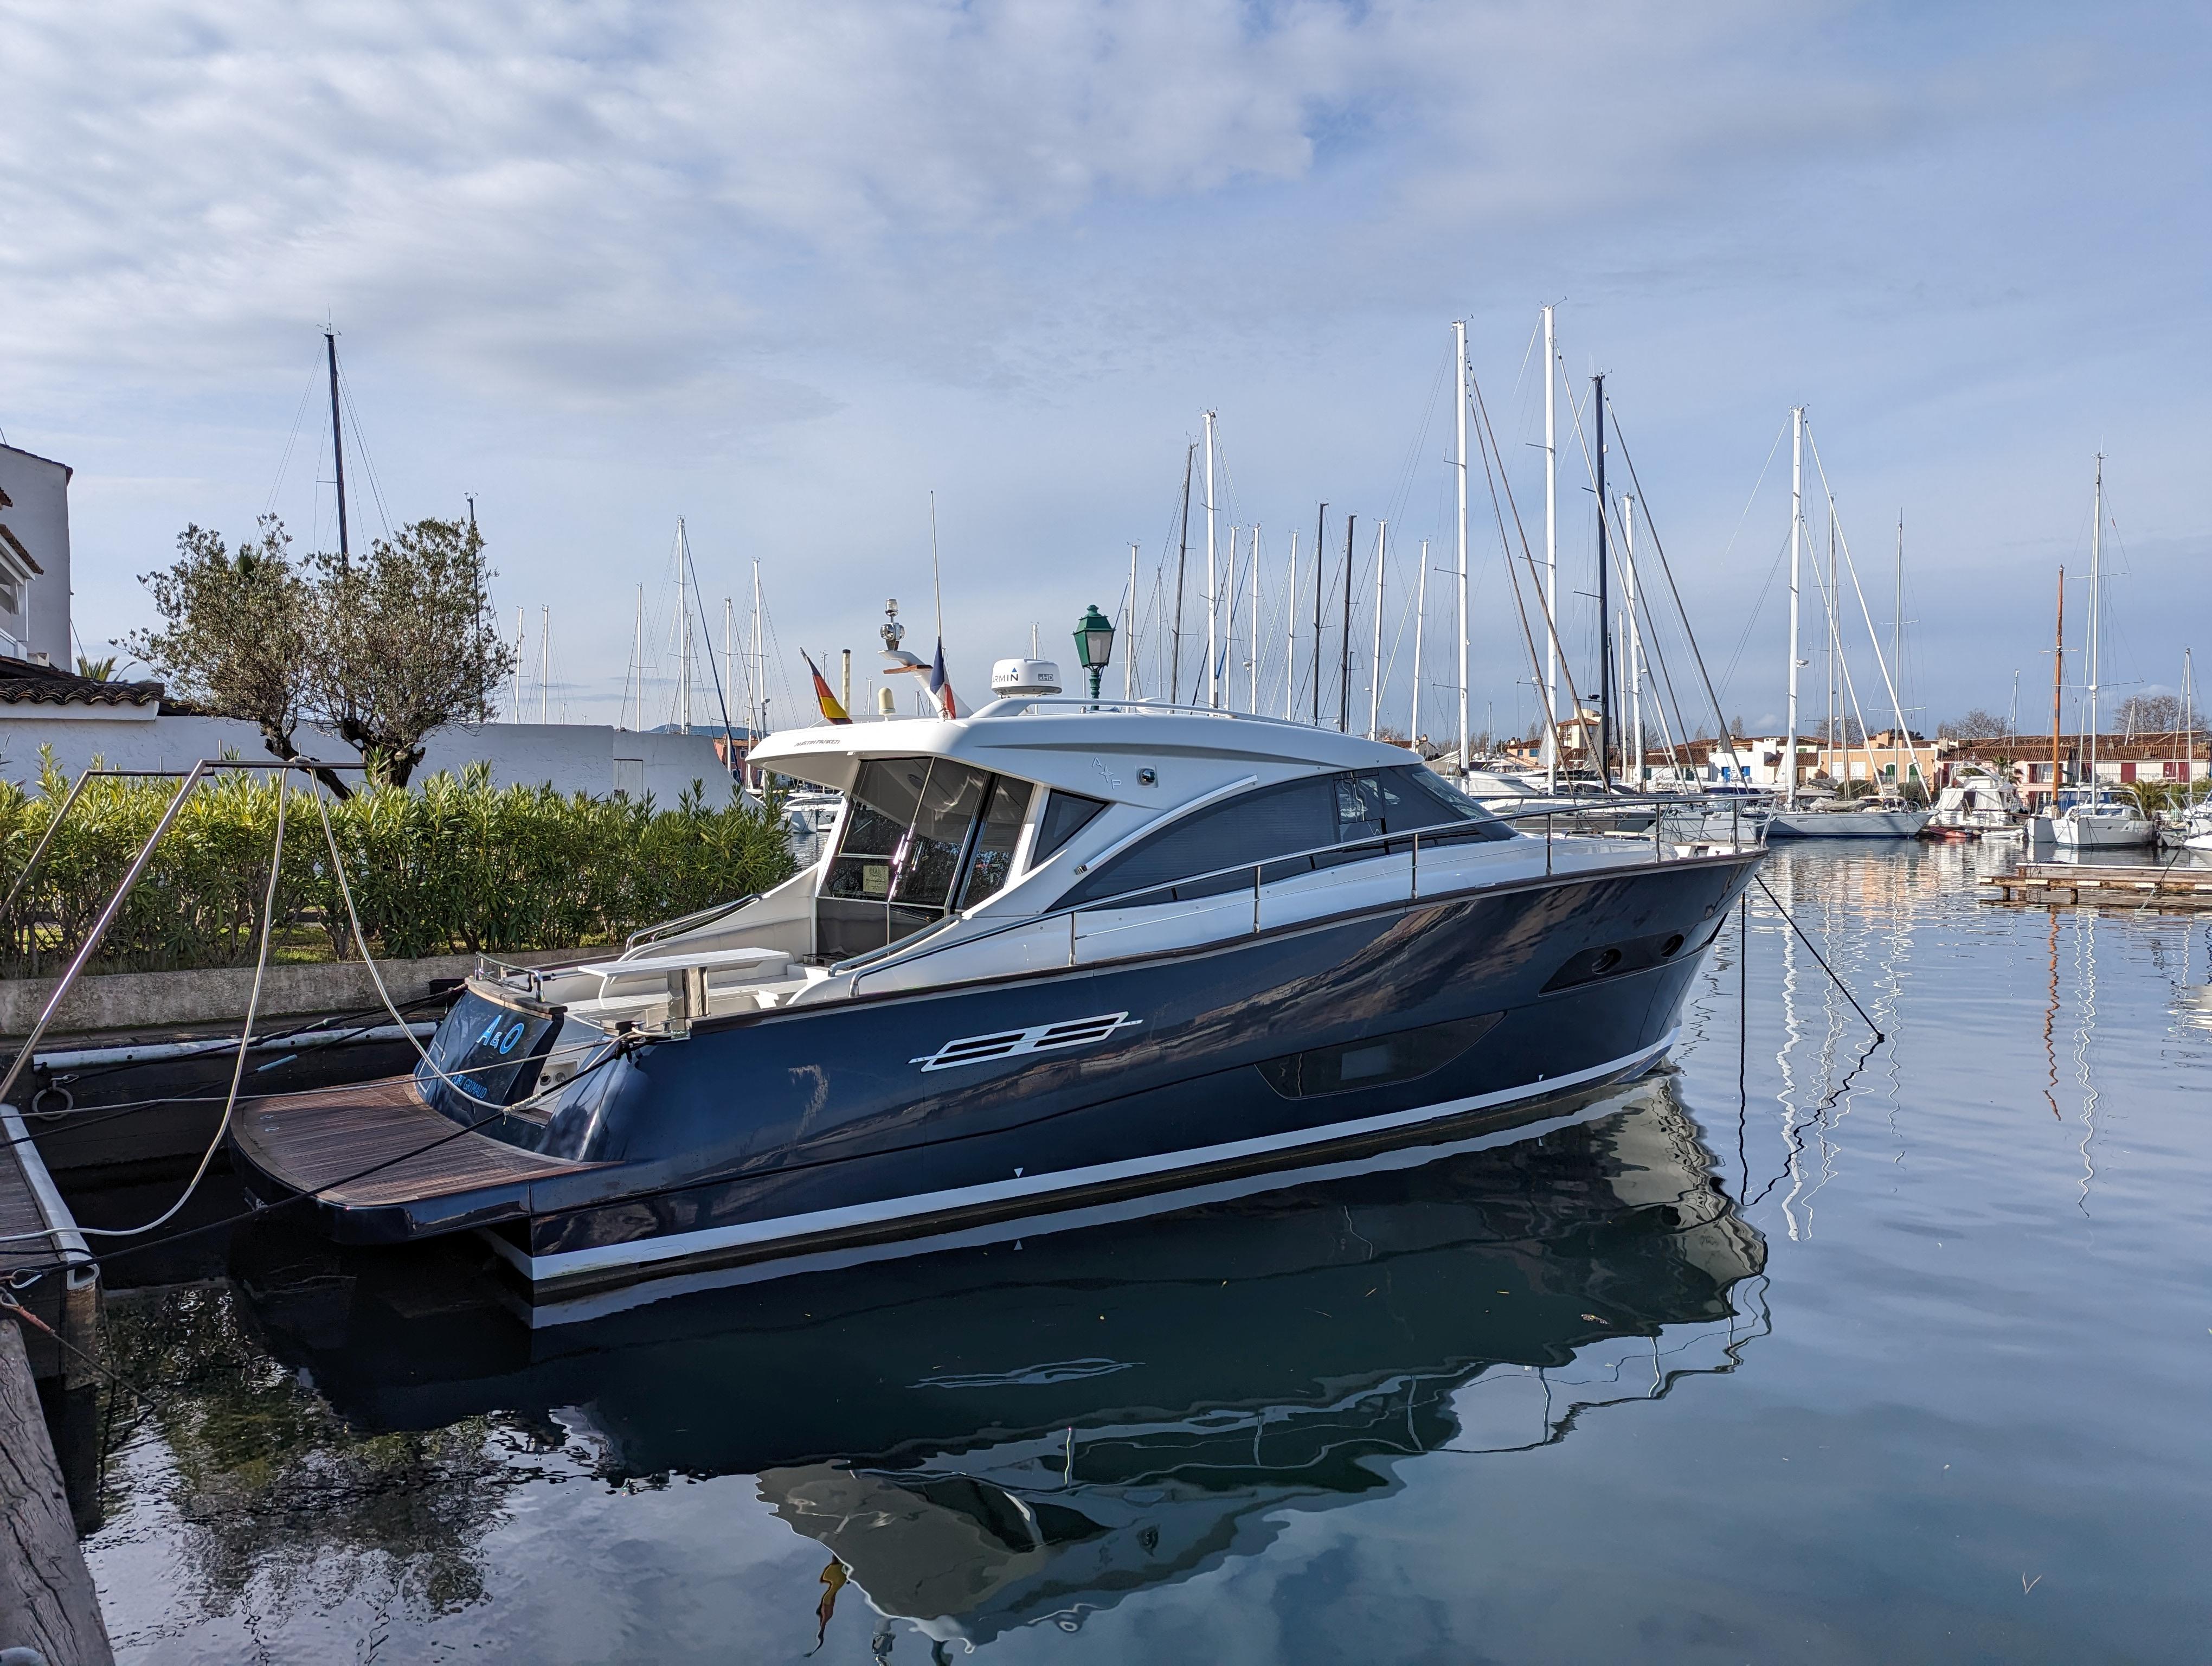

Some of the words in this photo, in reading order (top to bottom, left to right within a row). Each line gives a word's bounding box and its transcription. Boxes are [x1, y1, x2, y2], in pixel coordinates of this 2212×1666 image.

[477, 1015, 524, 1054] A&O
[452, 1074, 466, 1087] PORT
[463, 1079, 487, 1099] GRIMAUD
